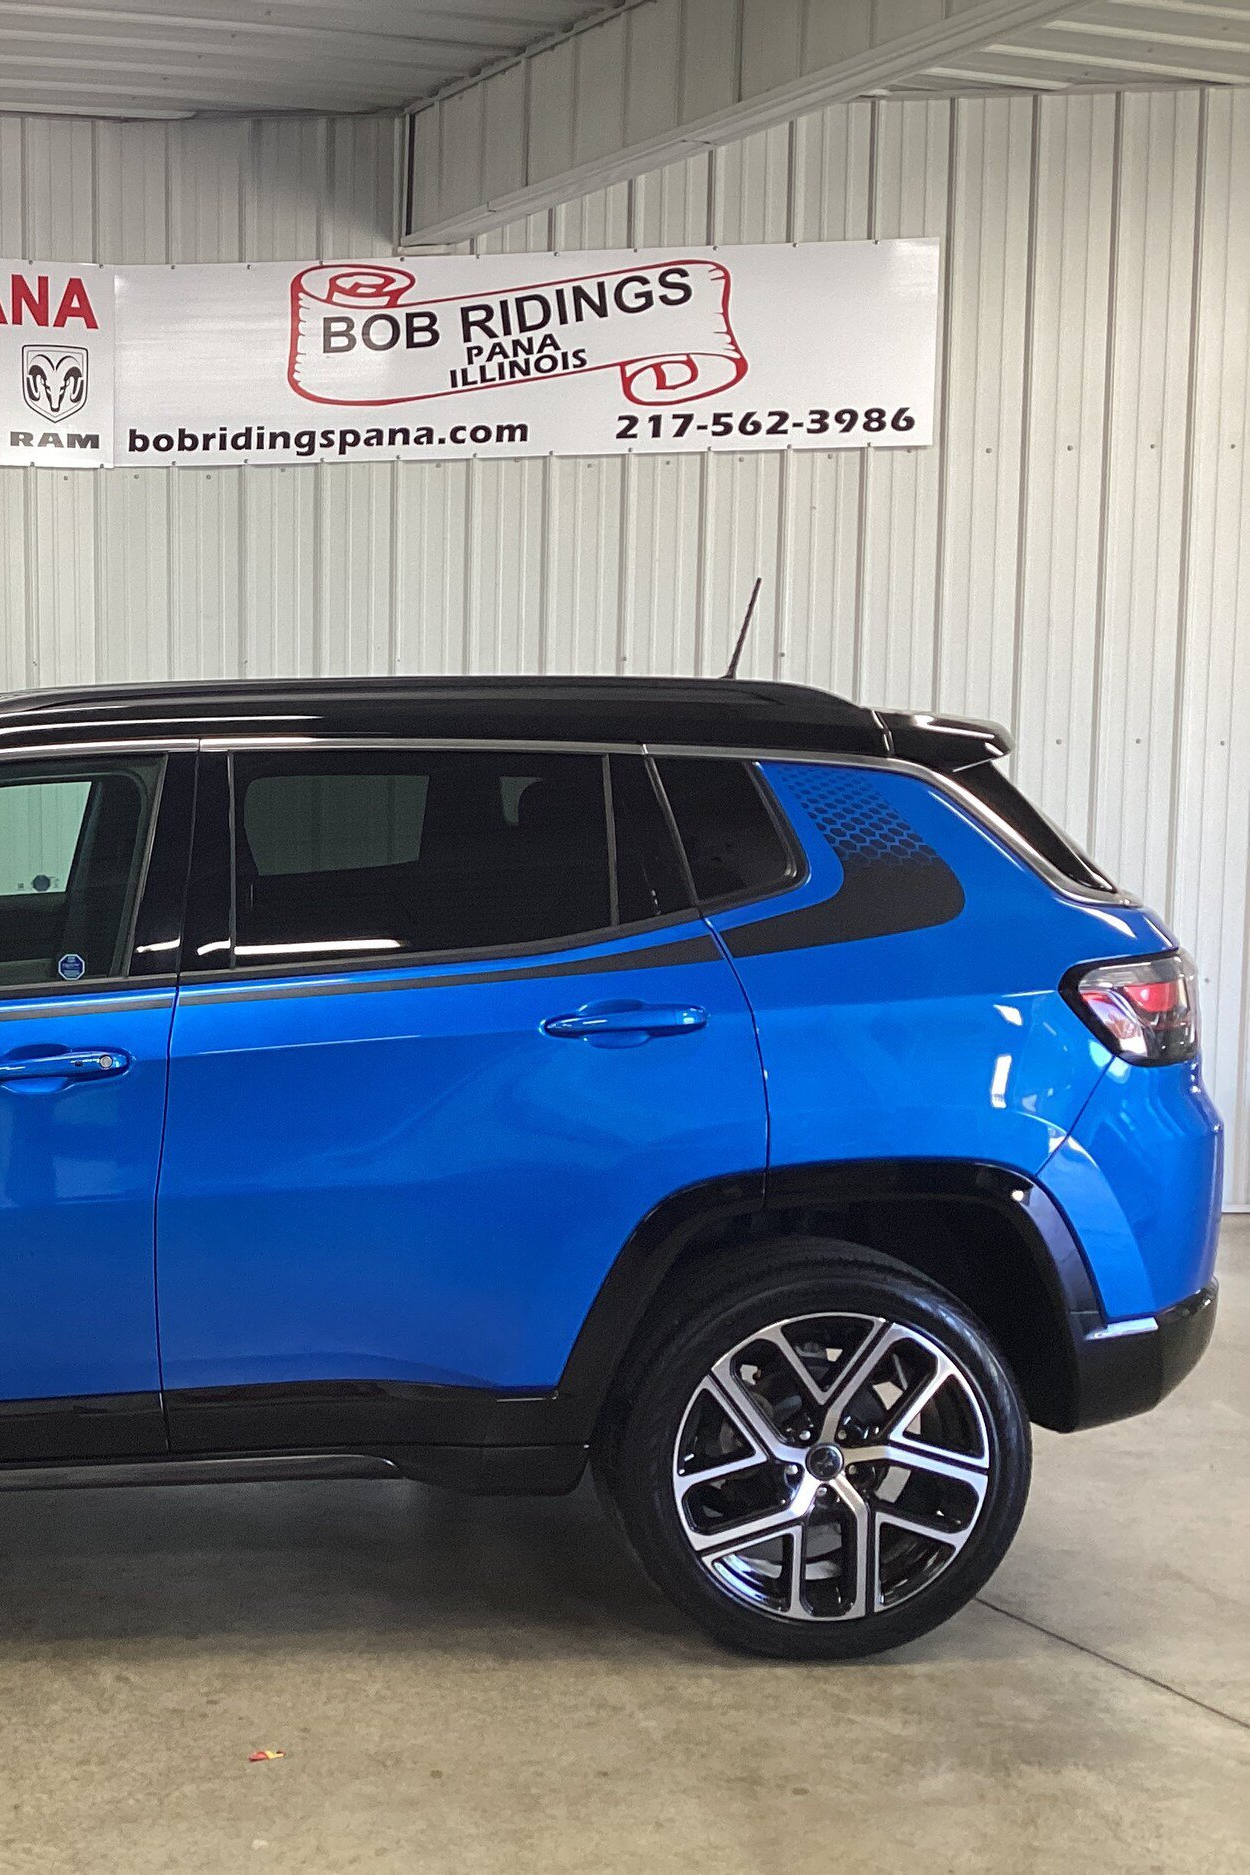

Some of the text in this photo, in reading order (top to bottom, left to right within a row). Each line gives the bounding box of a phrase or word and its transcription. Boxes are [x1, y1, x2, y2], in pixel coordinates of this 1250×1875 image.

[322, 267, 693, 354] BOB RIDINGS
[466, 332, 562, 366] PANA
[449, 348, 588, 389] ILLINOIS
[9, 430, 100, 449] RAM
[128, 422, 529, 457] bobridingspana.com
[615, 406, 916, 439] 217-562-3986
